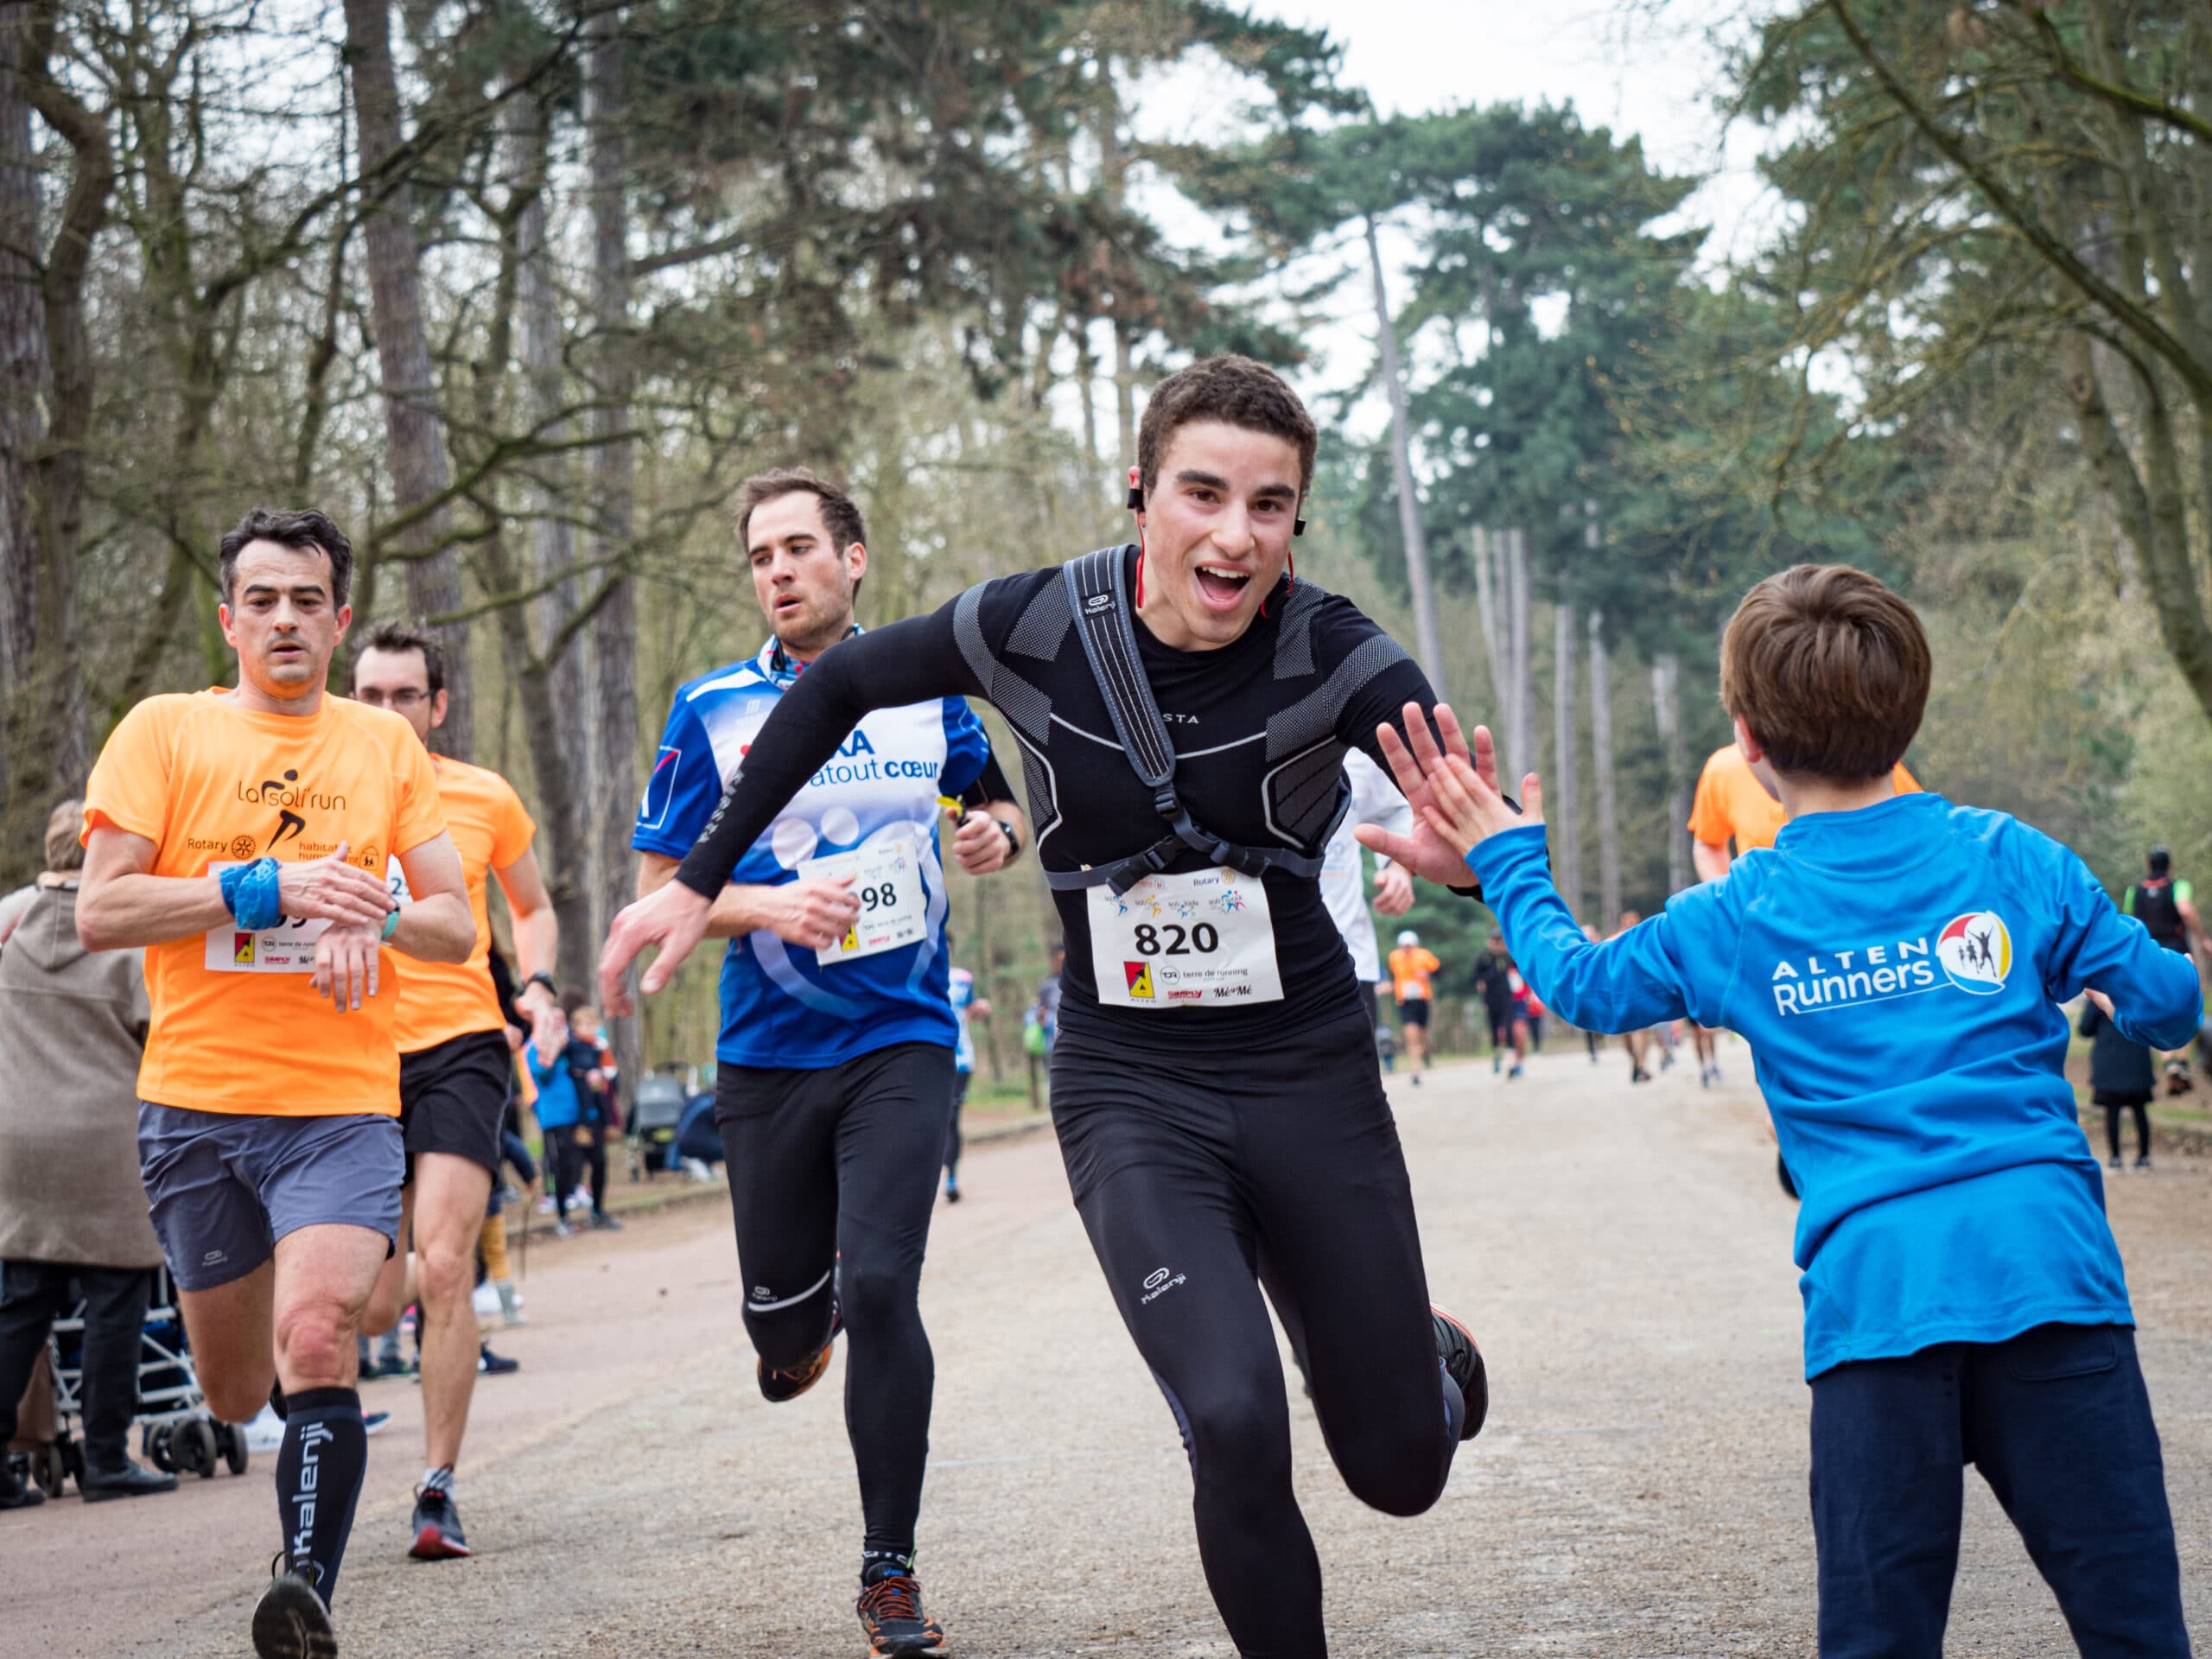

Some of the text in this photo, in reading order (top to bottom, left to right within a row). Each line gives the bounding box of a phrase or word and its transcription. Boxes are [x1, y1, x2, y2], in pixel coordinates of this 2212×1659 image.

[810, 759, 882, 787] atout
[188, 837, 228, 852] Rotary
[1193, 875, 1220, 887] Rotary
[851, 882, 897, 912] 98
[1134, 922, 1219, 956] 820
[1217, 967, 1249, 976] running
[1771, 937, 1929, 981] ALTEN
[1773, 959, 1935, 1016] Runners
